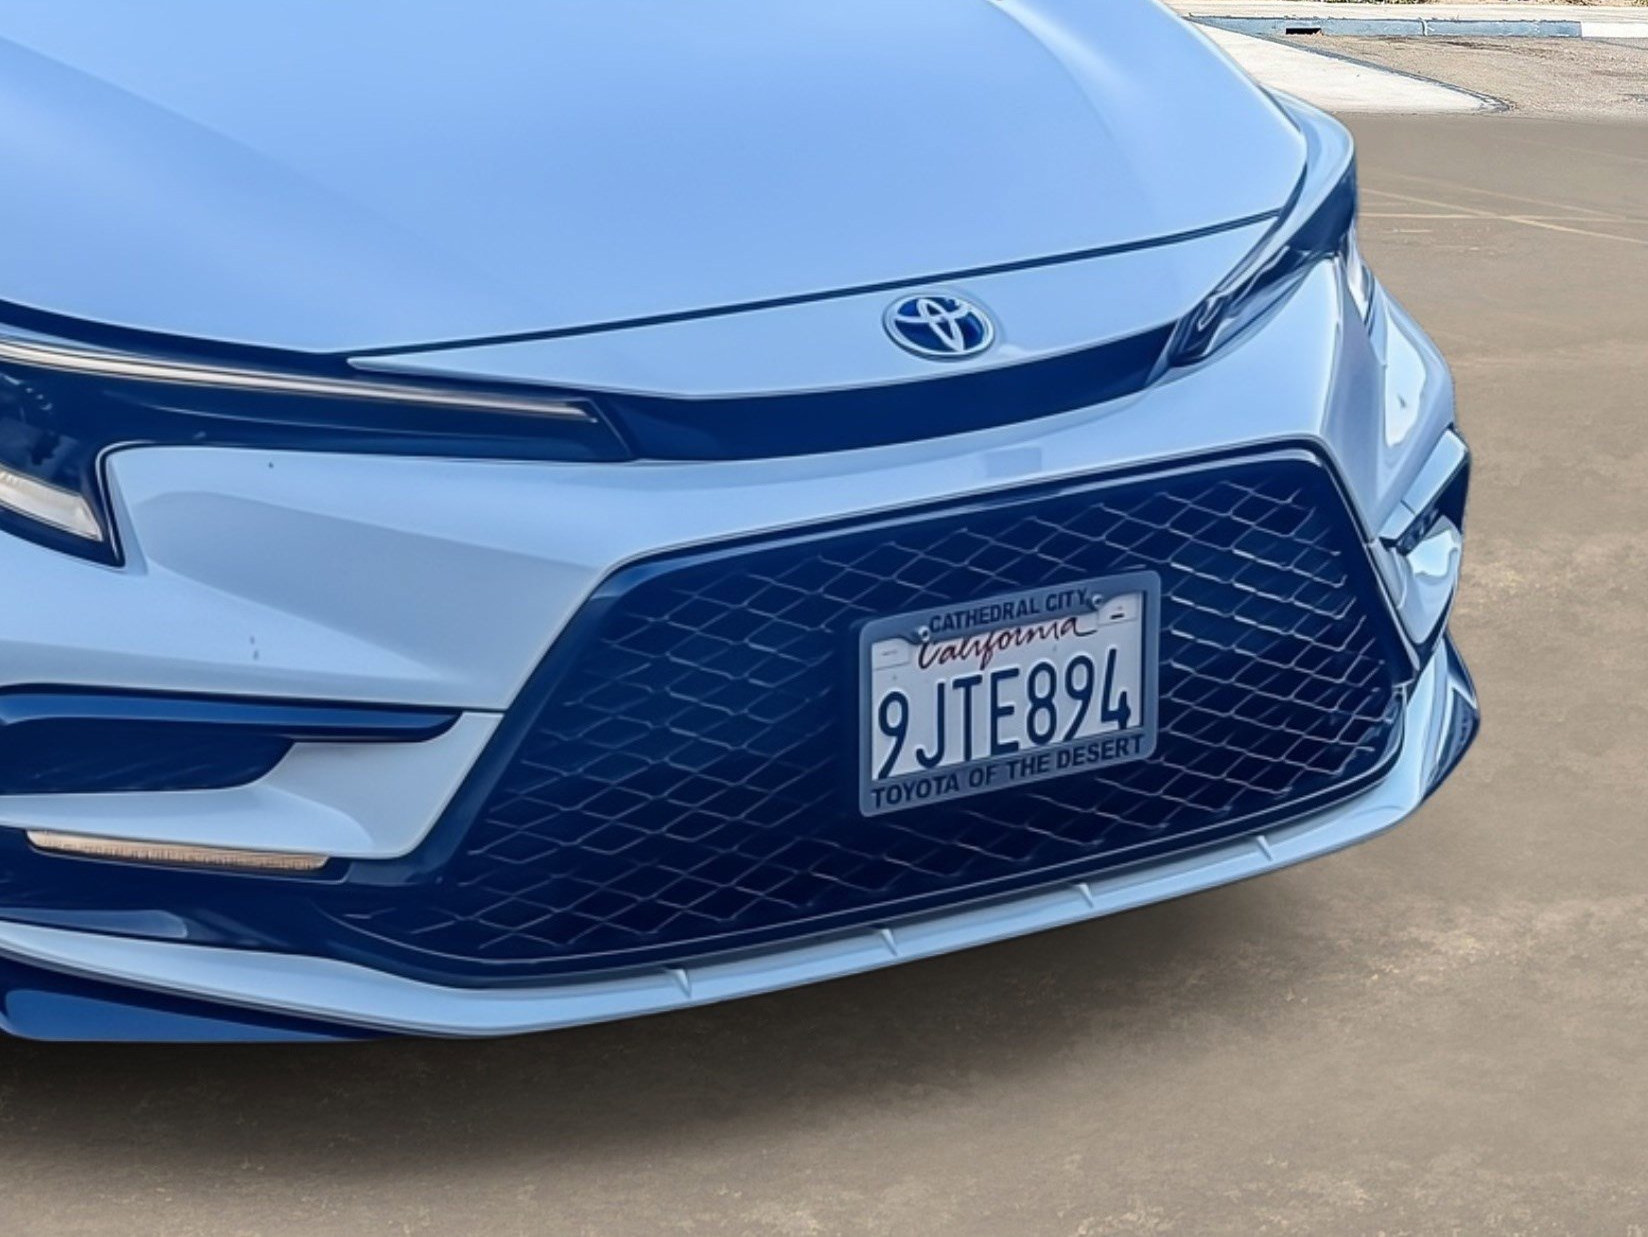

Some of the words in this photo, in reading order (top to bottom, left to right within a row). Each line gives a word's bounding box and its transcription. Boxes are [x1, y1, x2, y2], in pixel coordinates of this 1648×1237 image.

[918, 615, 1098, 671] California
[929, 602, 1041, 634] CATHEDRAL
[1045, 588, 1092, 612] CITY
[877, 648, 1131, 780] 9JTE894
[872, 774, 960, 809] TOYOTA
[968, 764, 998, 788] OF
[1006, 757, 1051, 780] THE
[1057, 735, 1145, 768] DESERT
